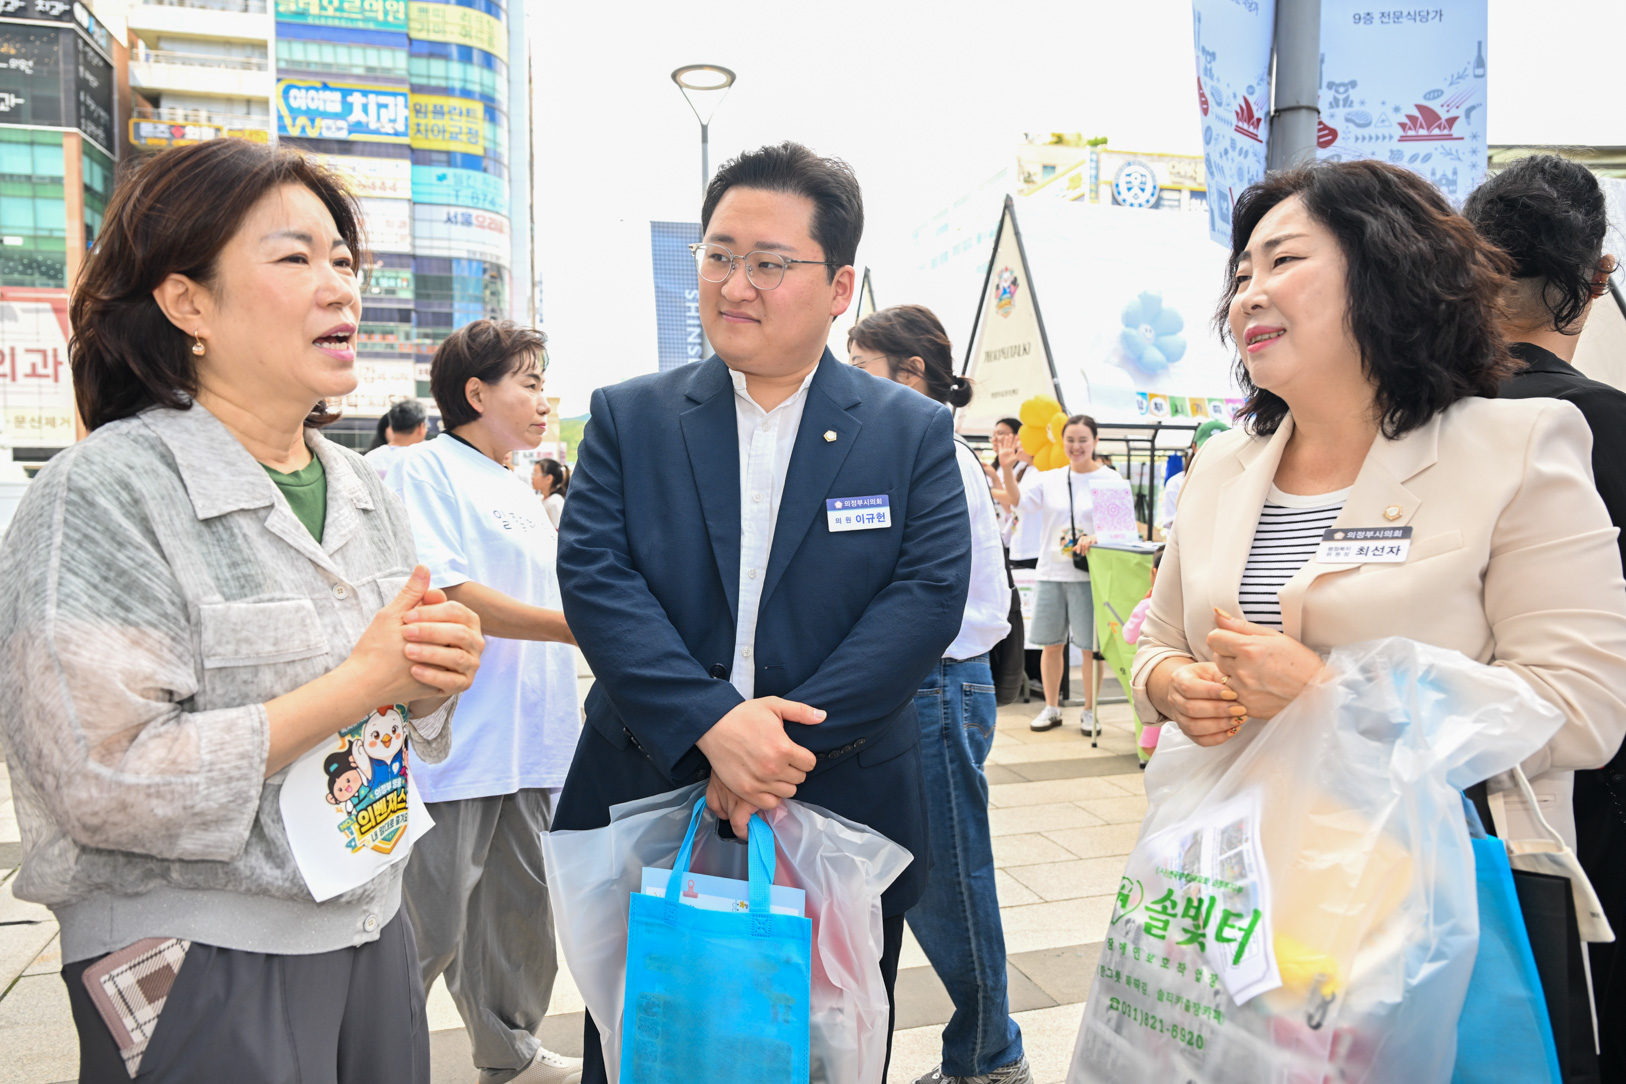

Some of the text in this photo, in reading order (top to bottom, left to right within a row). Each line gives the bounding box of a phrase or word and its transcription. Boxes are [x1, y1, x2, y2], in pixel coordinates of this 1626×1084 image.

[1353, 9, 1444, 25] 9층 전문식당가
[346, 91, 409, 133] 치과
[412, 102, 479, 126] 임플란트
[412, 122, 480, 145] 치아교정
[14, 414, 72, 429] 문신제거
[844, 497, 883, 508] 의정부시의회
[855, 511, 886, 525] 이규헌
[1346, 529, 1403, 539] 의정부시의회
[1355, 545, 1401, 557] 최선자
[357, 787, 408, 834] 의벤져스
[1143, 887, 1262, 966] 솔빛터
